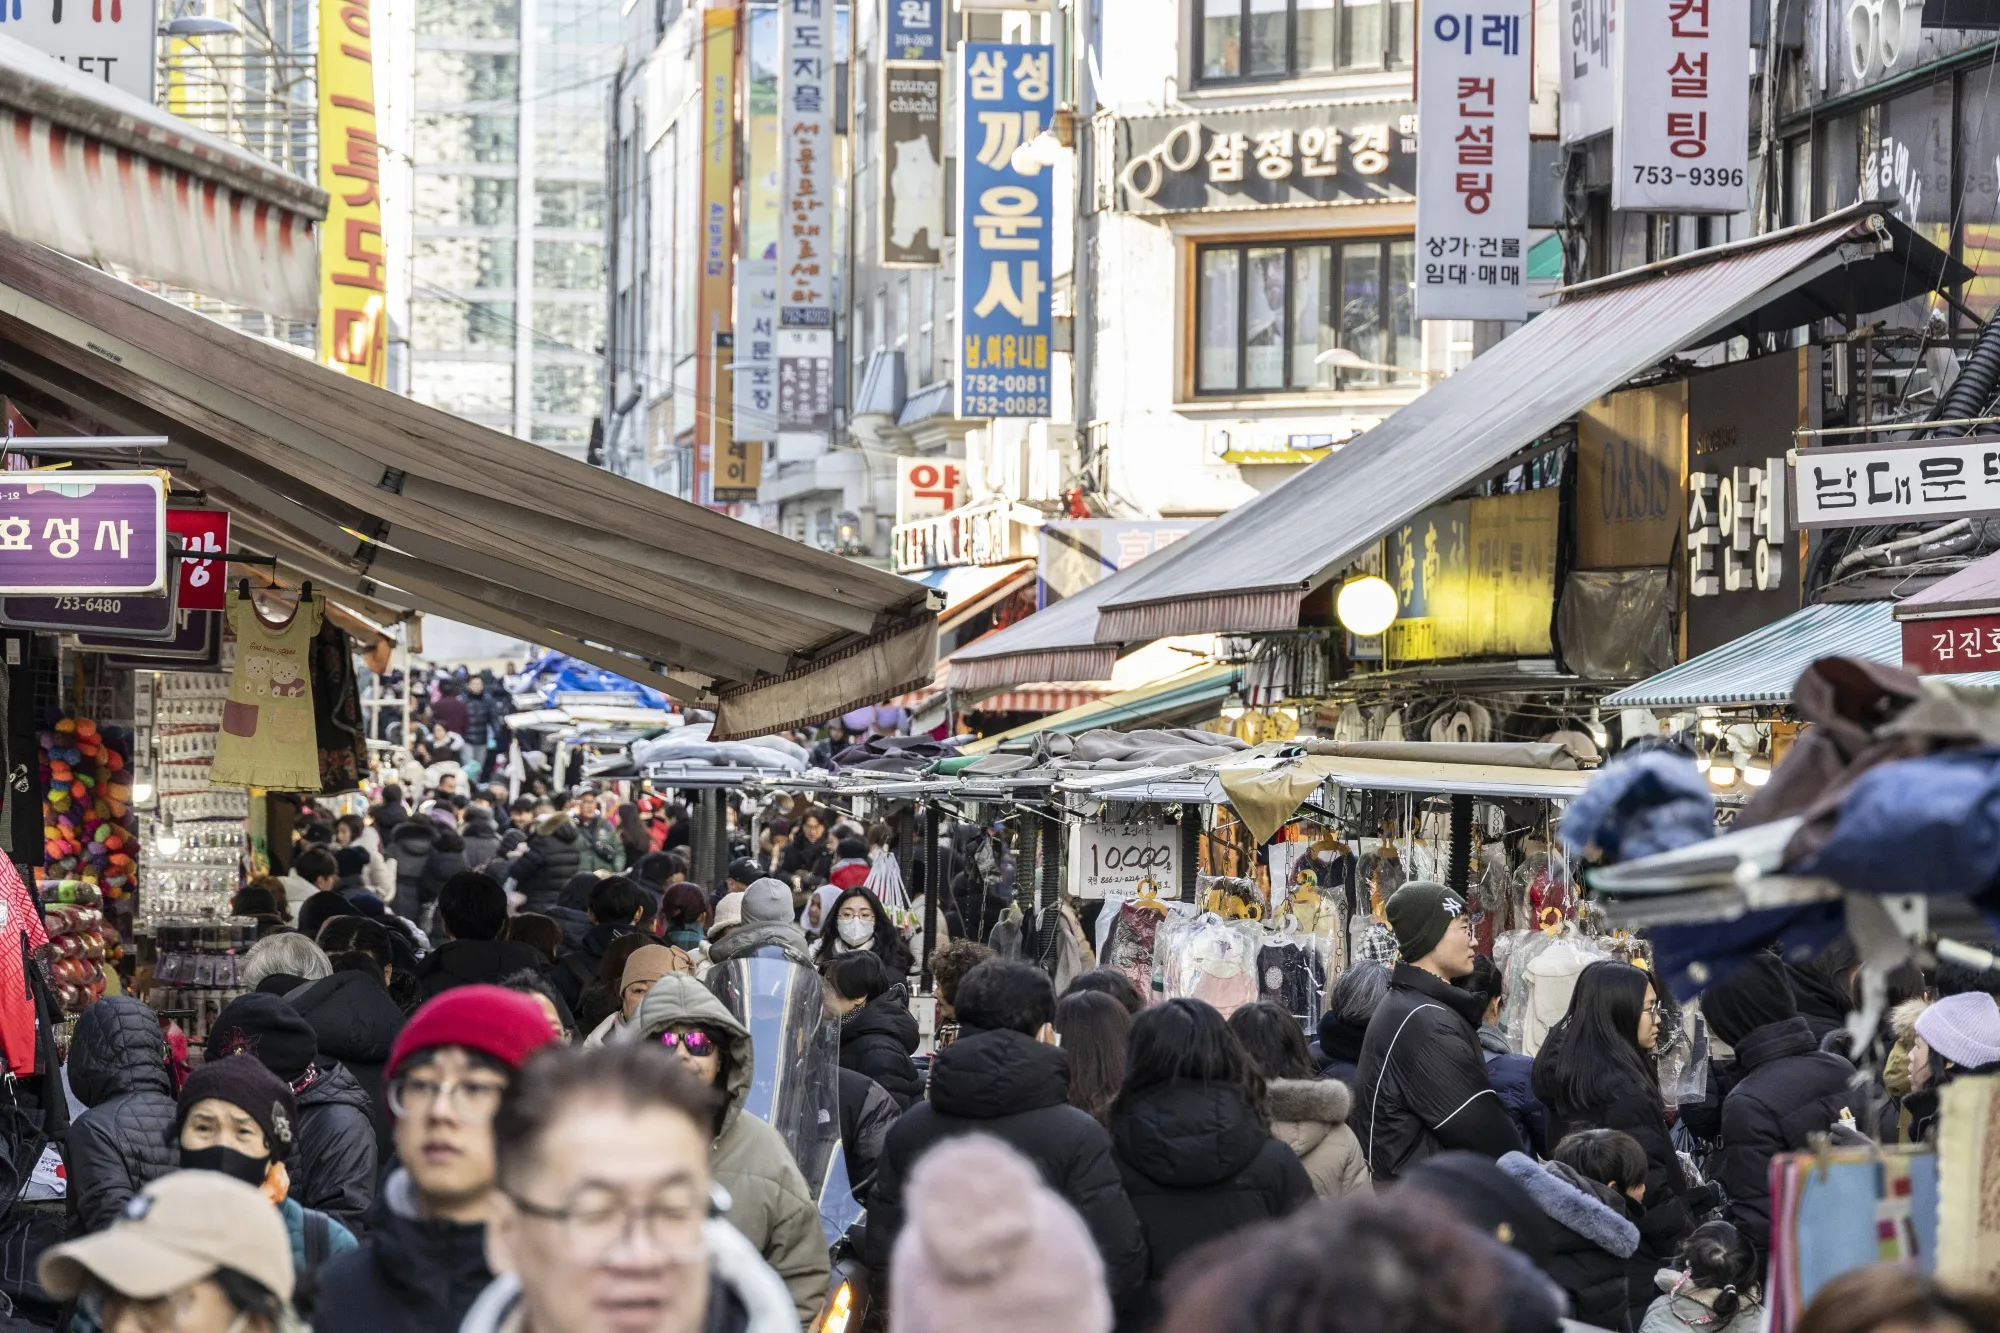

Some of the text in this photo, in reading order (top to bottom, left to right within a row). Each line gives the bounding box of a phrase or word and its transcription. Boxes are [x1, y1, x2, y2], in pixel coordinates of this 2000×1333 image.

[1434, 14, 1520, 56] 이레
[889, 80, 938, 98] mung
[967, 51, 1050, 101] 삼성
[1667, 0, 1710, 159] 컨설팅
[1205, 124, 1390, 183] 삼정안경
[1455, 77, 1495, 215] 컨설팅
[1632, 166, 1744, 188] 753-9396
[965, 374, 1046, 393] 752-0081
[965, 396, 1048, 415] 752-0082
[909, 464, 960, 511] 약
[0, 516, 134, 560] 효성사
[55, 597, 121, 613] 753-6480
